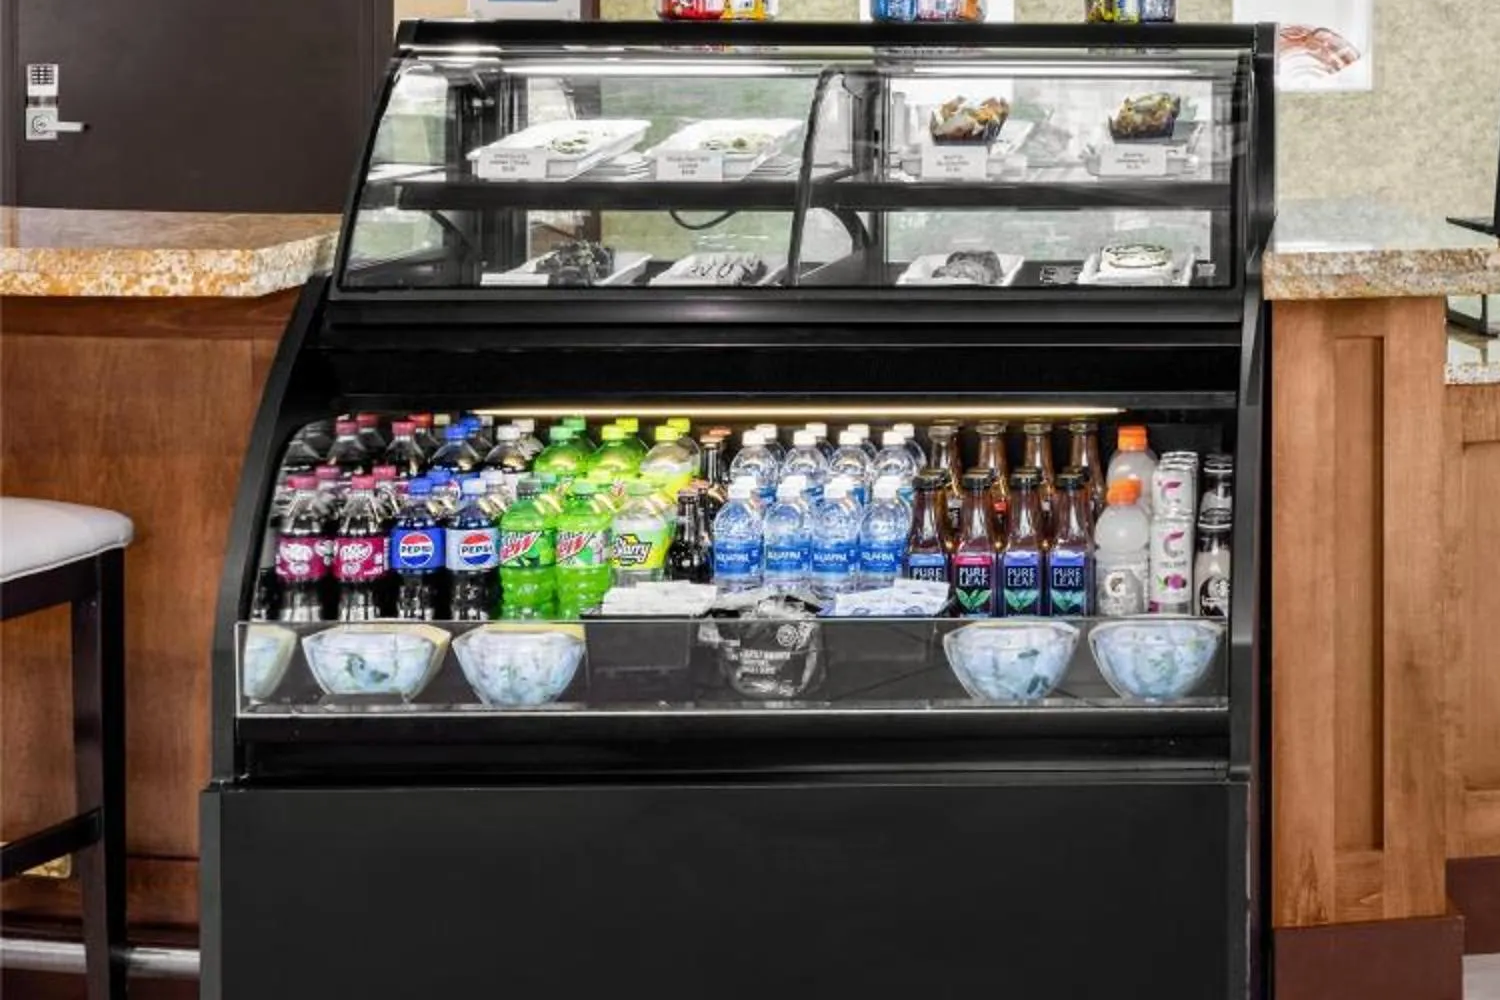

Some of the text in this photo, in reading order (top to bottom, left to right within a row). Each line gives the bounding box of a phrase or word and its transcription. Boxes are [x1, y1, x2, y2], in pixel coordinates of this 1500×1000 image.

[912, 567, 943, 577] PURE
[958, 567, 987, 577] PURE
[1006, 567, 1035, 577] PURE
[1053, 567, 1082, 577] PURE
